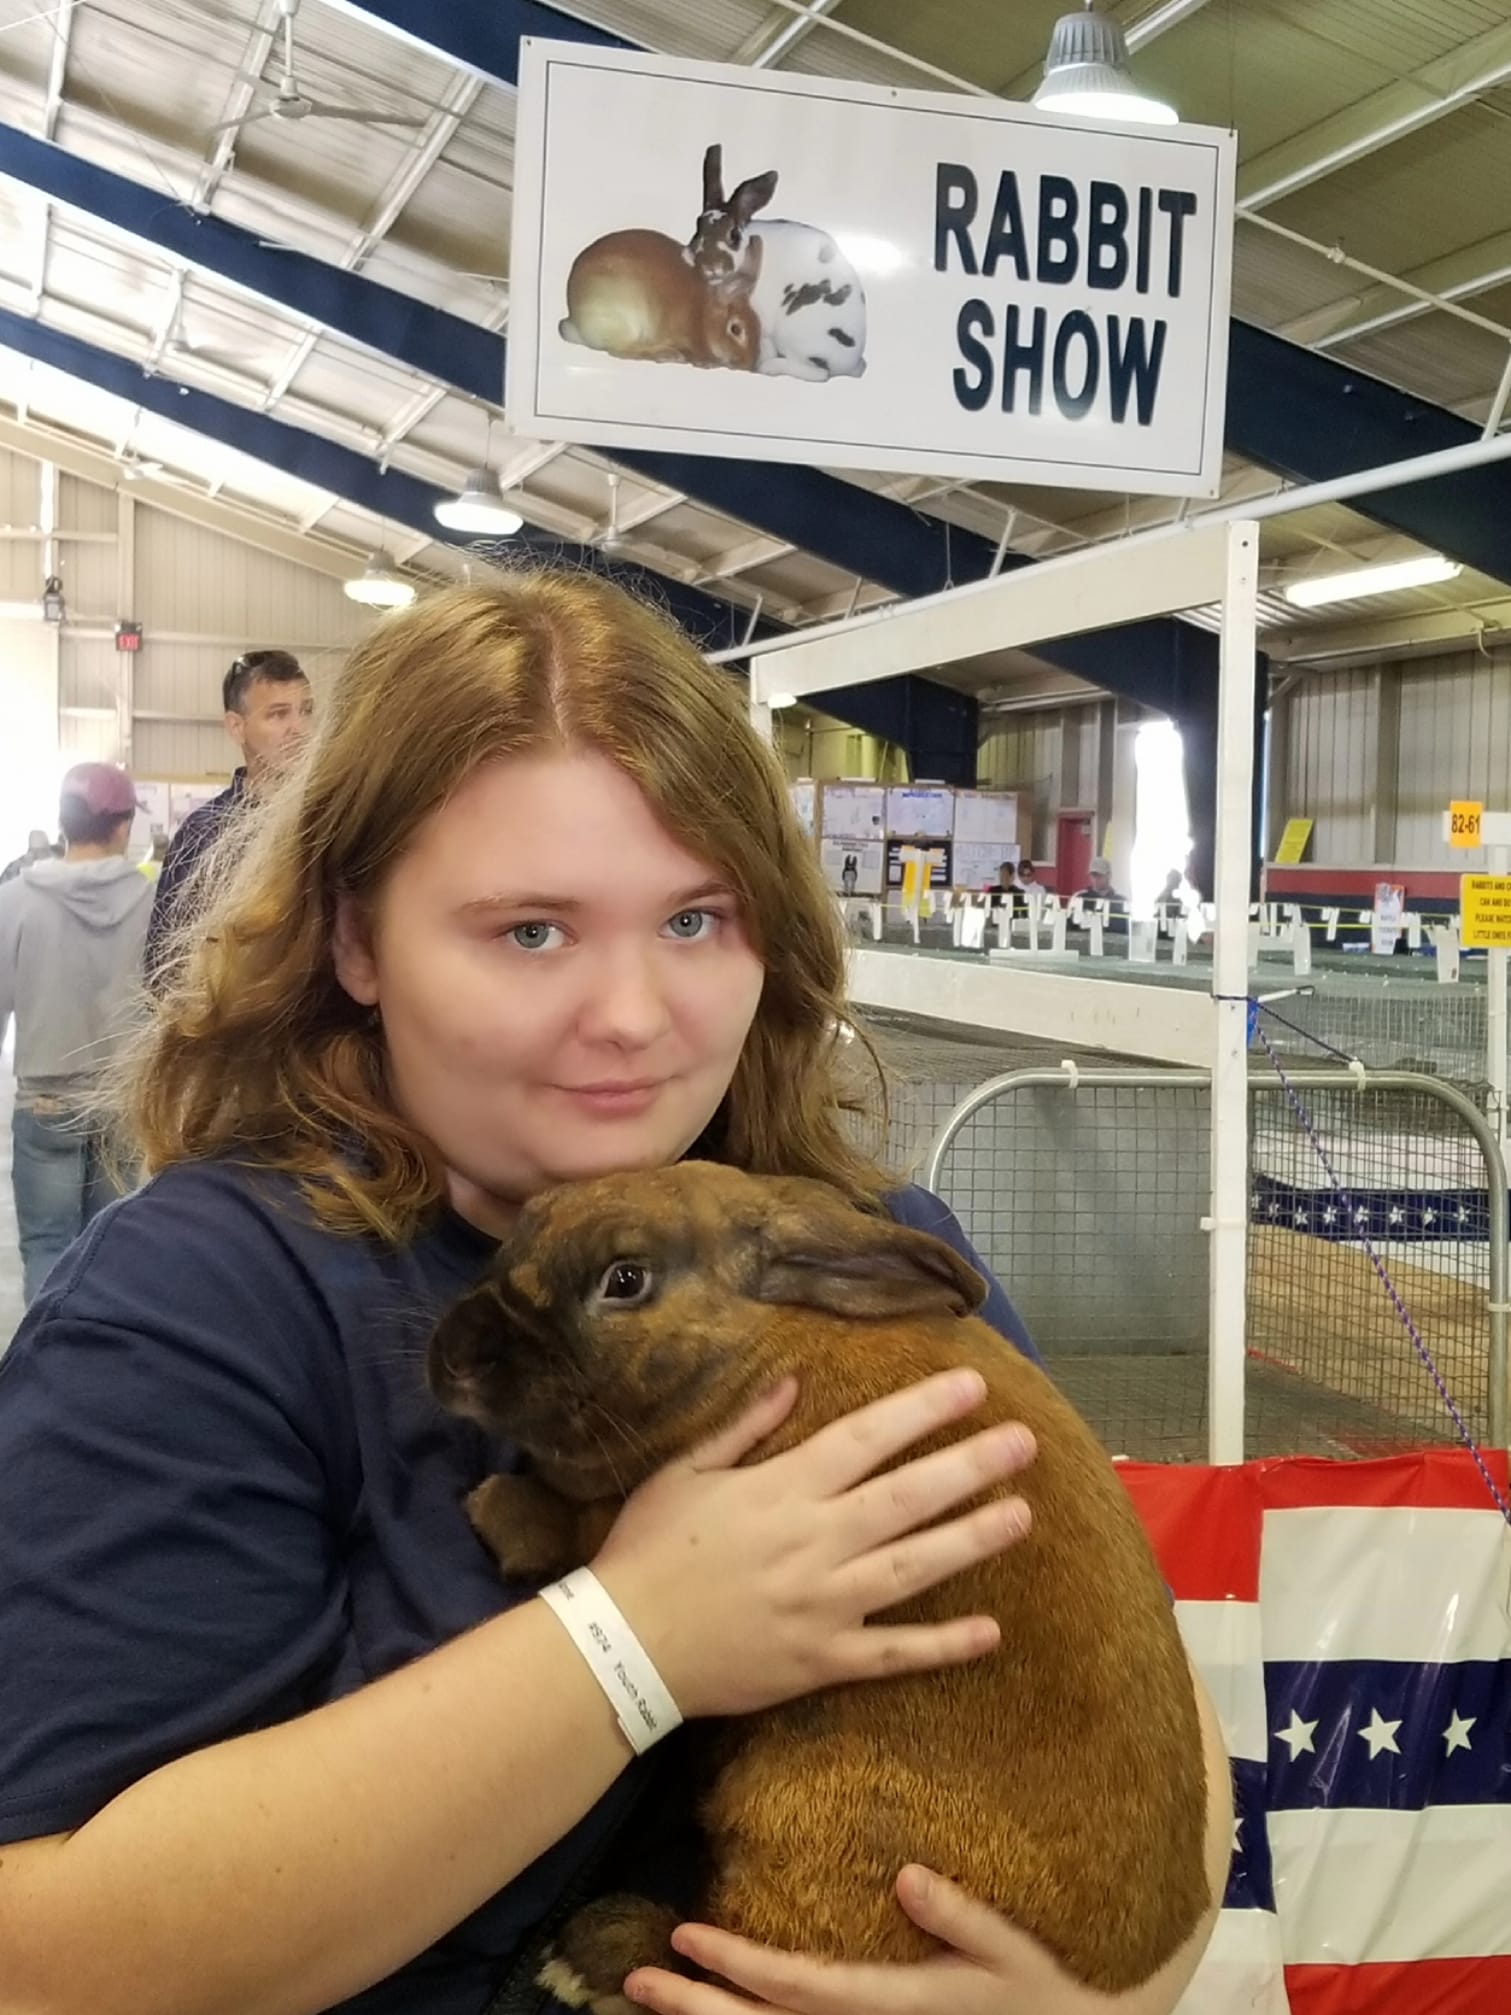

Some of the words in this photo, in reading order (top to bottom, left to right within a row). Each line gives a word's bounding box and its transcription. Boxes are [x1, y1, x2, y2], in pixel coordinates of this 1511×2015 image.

[934, 162, 1197, 298] RABBIT
[952, 298, 1168, 426] SHOW
[119, 634, 139, 650] EXIT
[1451, 814, 1480, 834] 82-61
[1471, 879, 1493, 890] RABBITS
[1495, 881, 1505, 890] AND
[1480, 897, 1490, 906] CAN
[1492, 898, 1503, 906] AND
[1475, 913, 1494, 922] PLEASE
[1473, 930, 1490, 939] LITTLE
[613, 1659, 640, 1700] Youth
